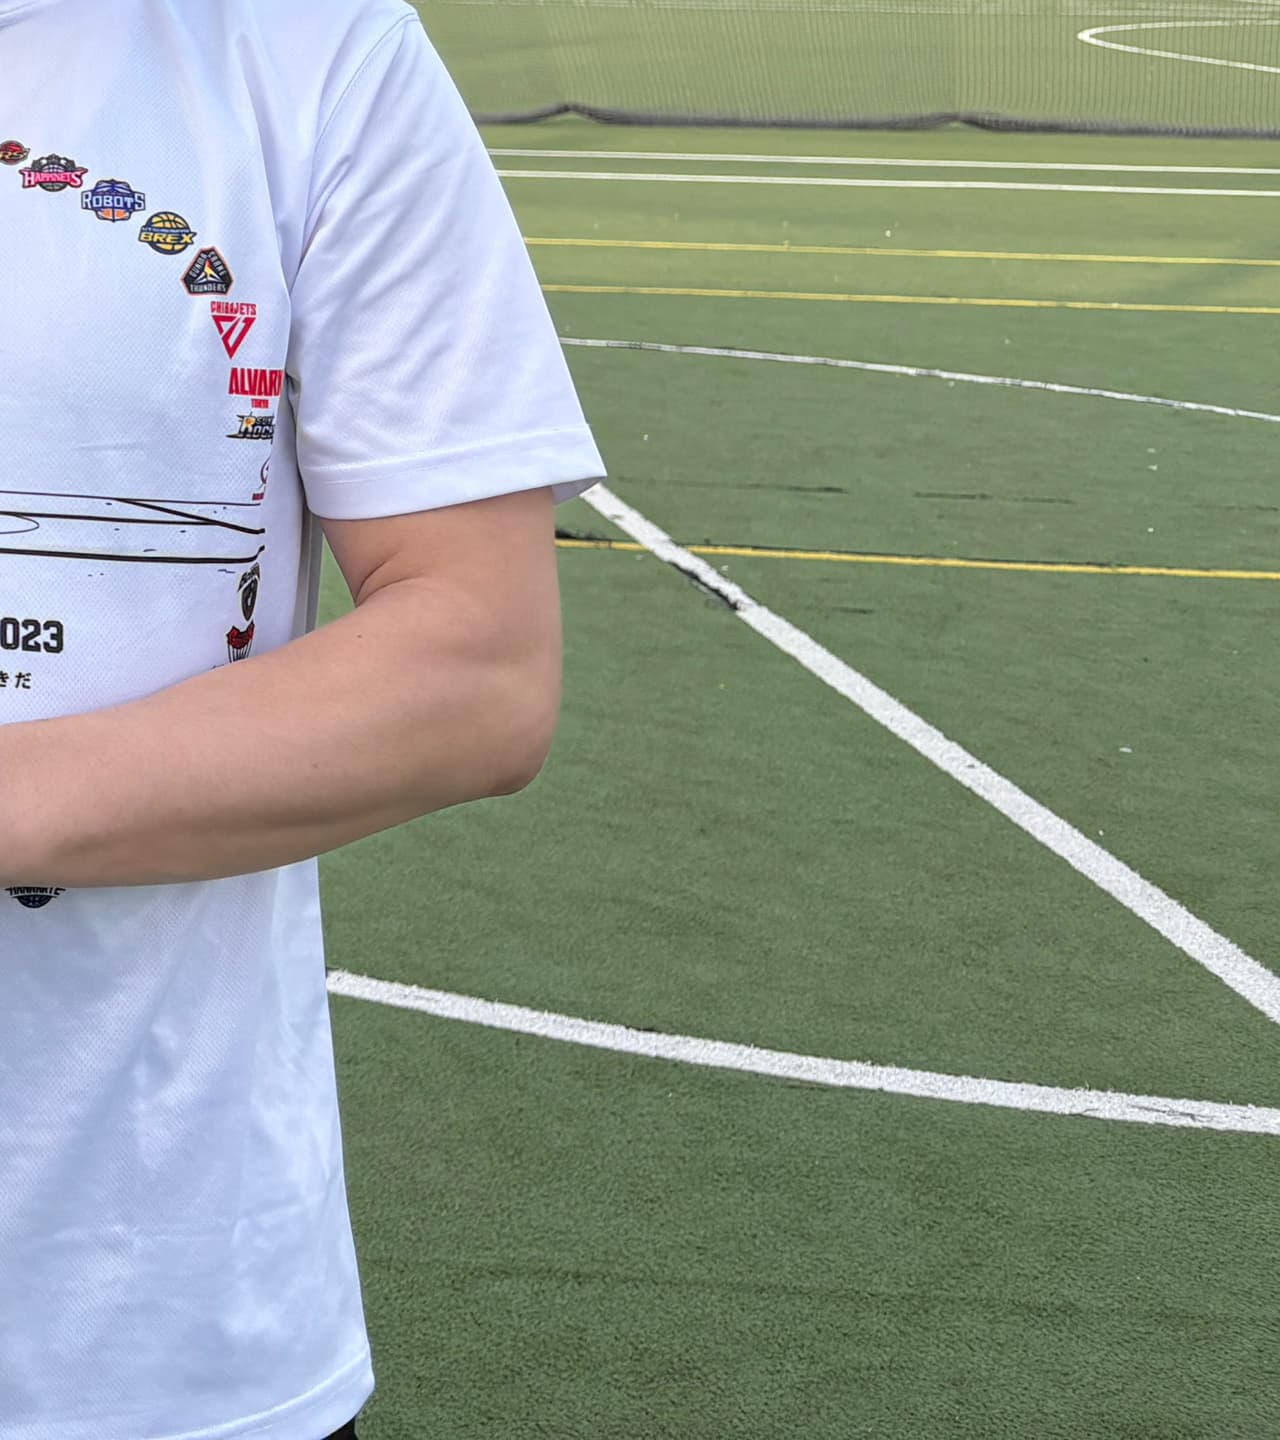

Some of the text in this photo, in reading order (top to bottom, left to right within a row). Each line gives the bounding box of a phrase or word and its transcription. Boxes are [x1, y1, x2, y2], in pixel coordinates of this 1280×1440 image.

[82, 191, 145, 210] ROBOTS
[140, 231, 194, 244] BREX
[190, 282, 227, 293] THUNDERS
